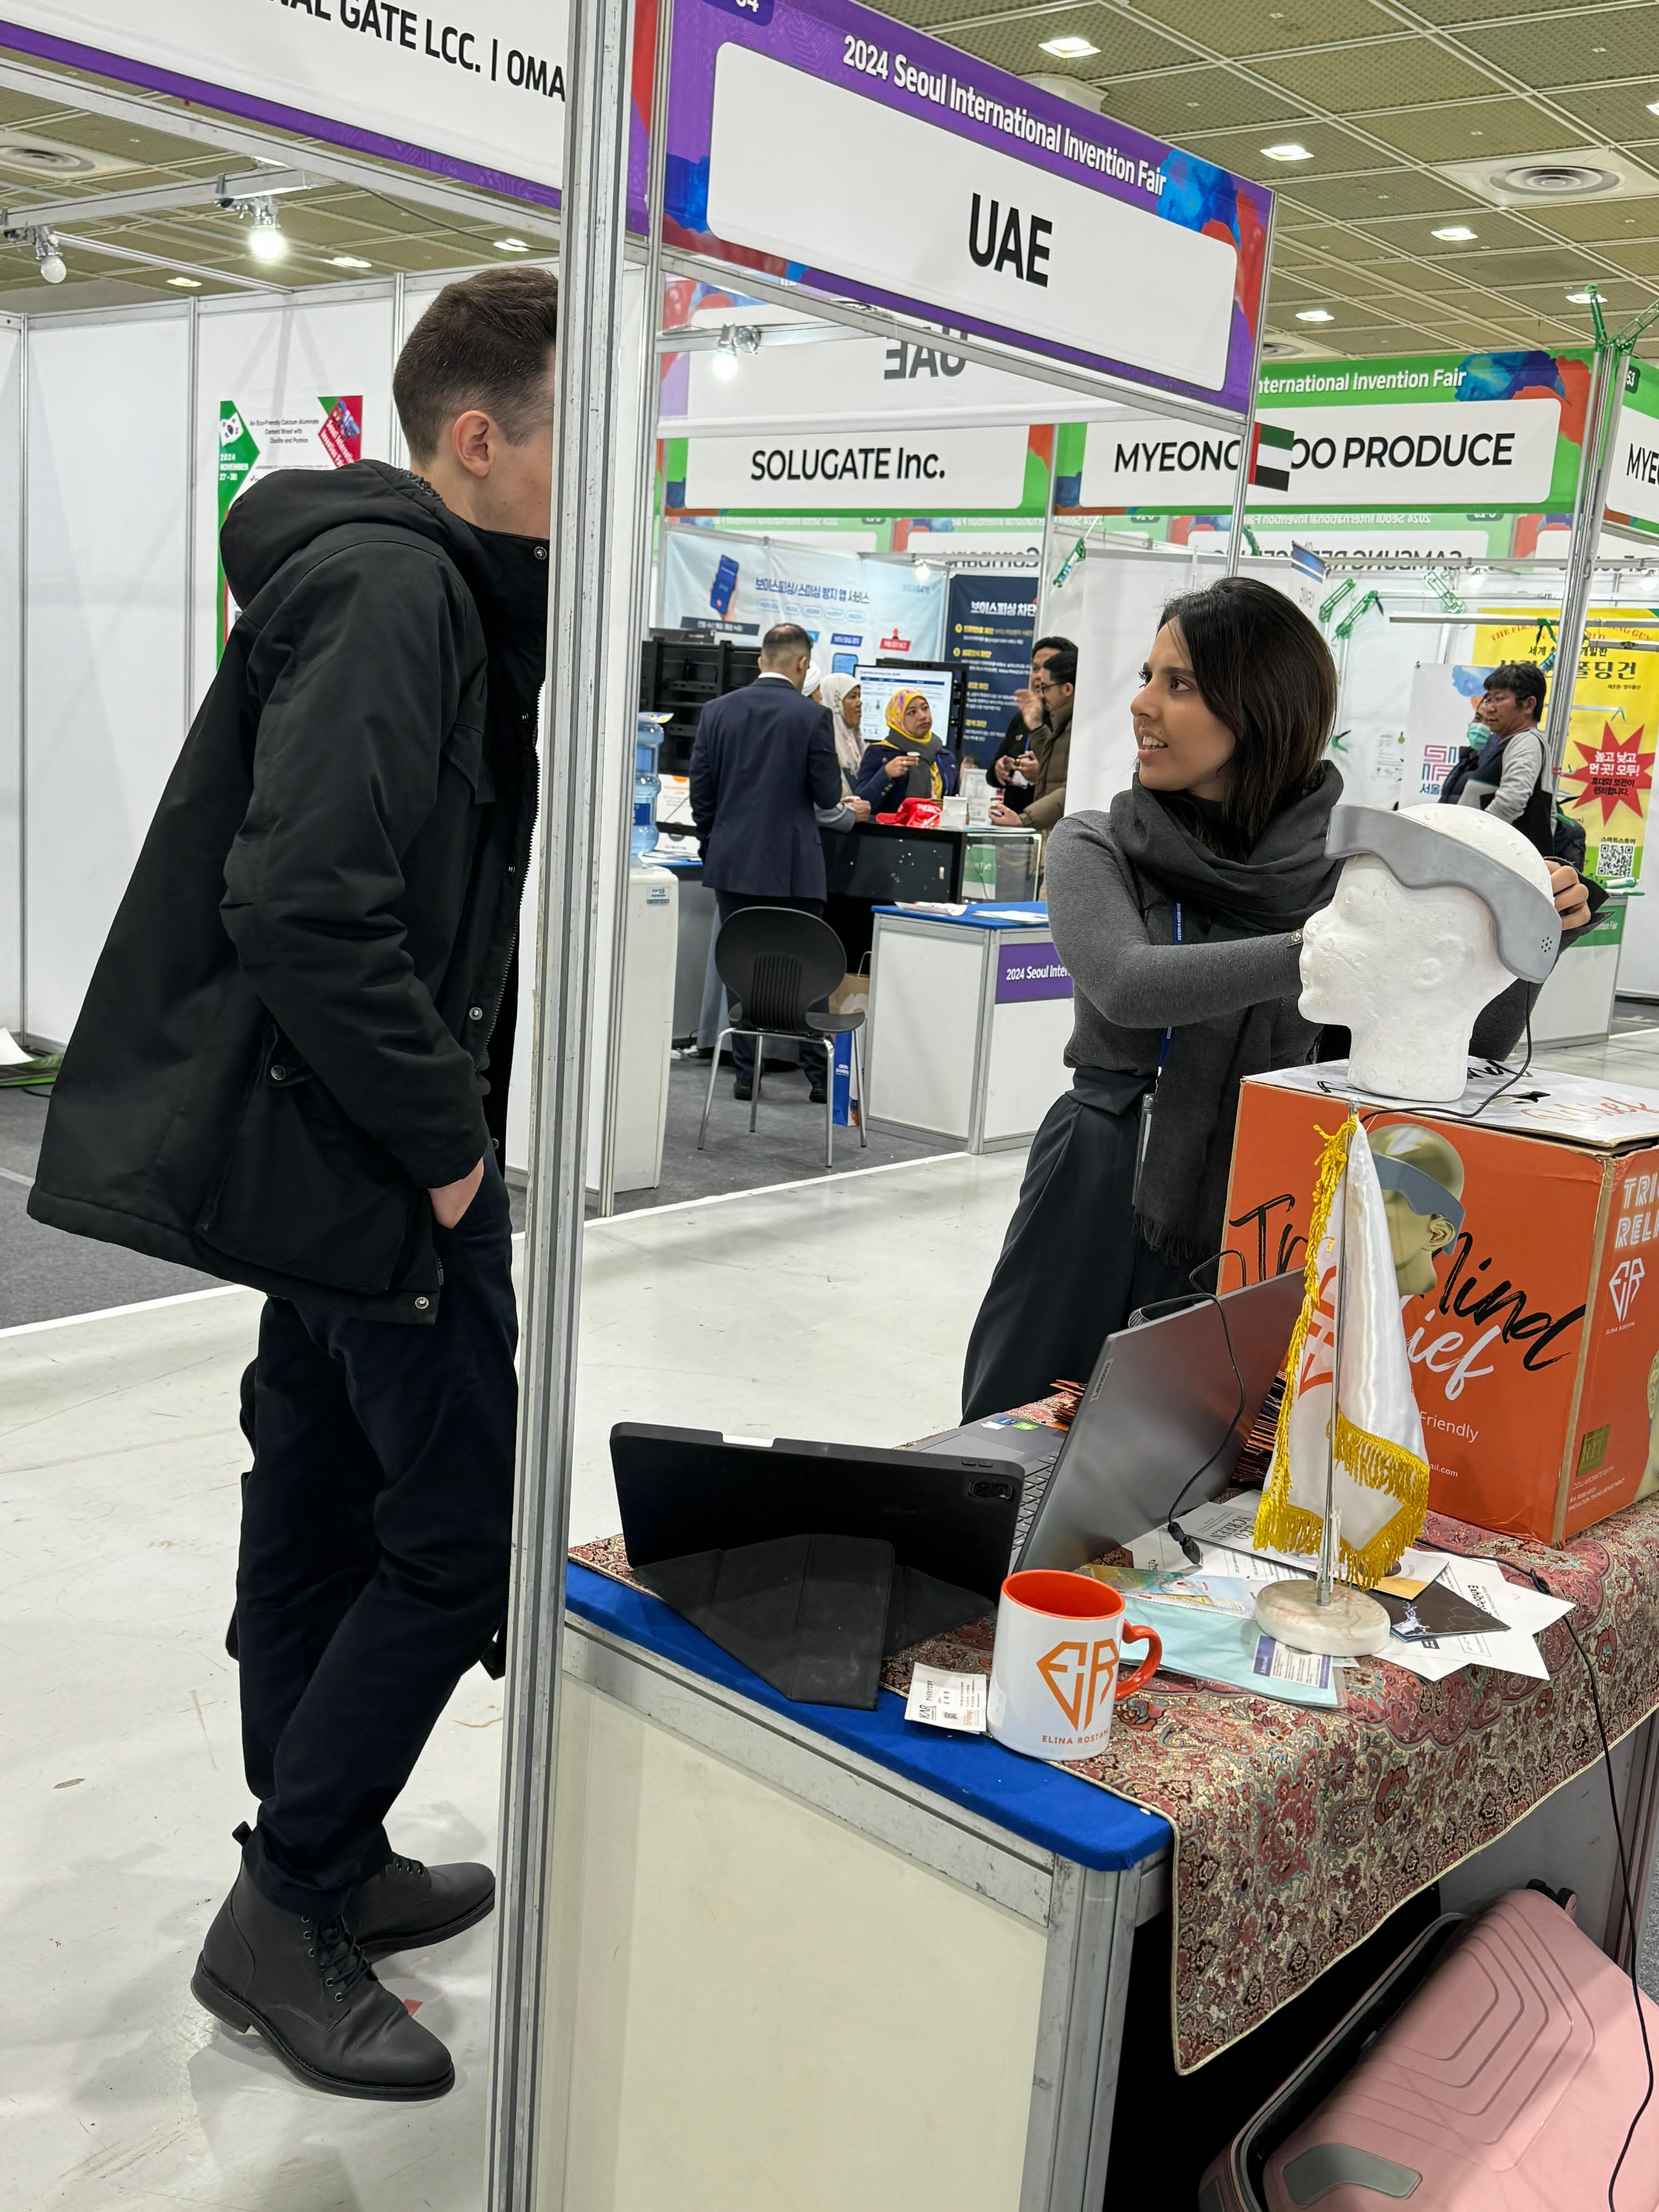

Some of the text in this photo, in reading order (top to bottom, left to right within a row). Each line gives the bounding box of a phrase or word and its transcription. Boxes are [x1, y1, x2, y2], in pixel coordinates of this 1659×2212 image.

[340, 0, 417, 50] GATE
[425, 19, 480, 73] LCC.
[843, 35, 1166, 196] 2024 Seoul International Invention Fair
[969, 193, 1053, 288] UAE
[1258, 369, 1467, 394] nternational Invention Fair
[219, 453, 236, 461] 2024
[751, 447, 945, 481] SOLUGATE Inc.
[1343, 432, 1515, 470] PRODUCE
[1627, 443, 1659, 485] MYE
[1419, 783, 1441, 795] 서울
[1006, 968, 1025, 981] 2024
[1026, 965, 1049, 979] Seoul
[1624, 1172, 1659, 1209] TRI
[1420, 1411, 1479, 1443] Friendly
[1210, 1515, 1252, 1540] SCREEN
[1042, 1735, 1073, 1745] ELINA
